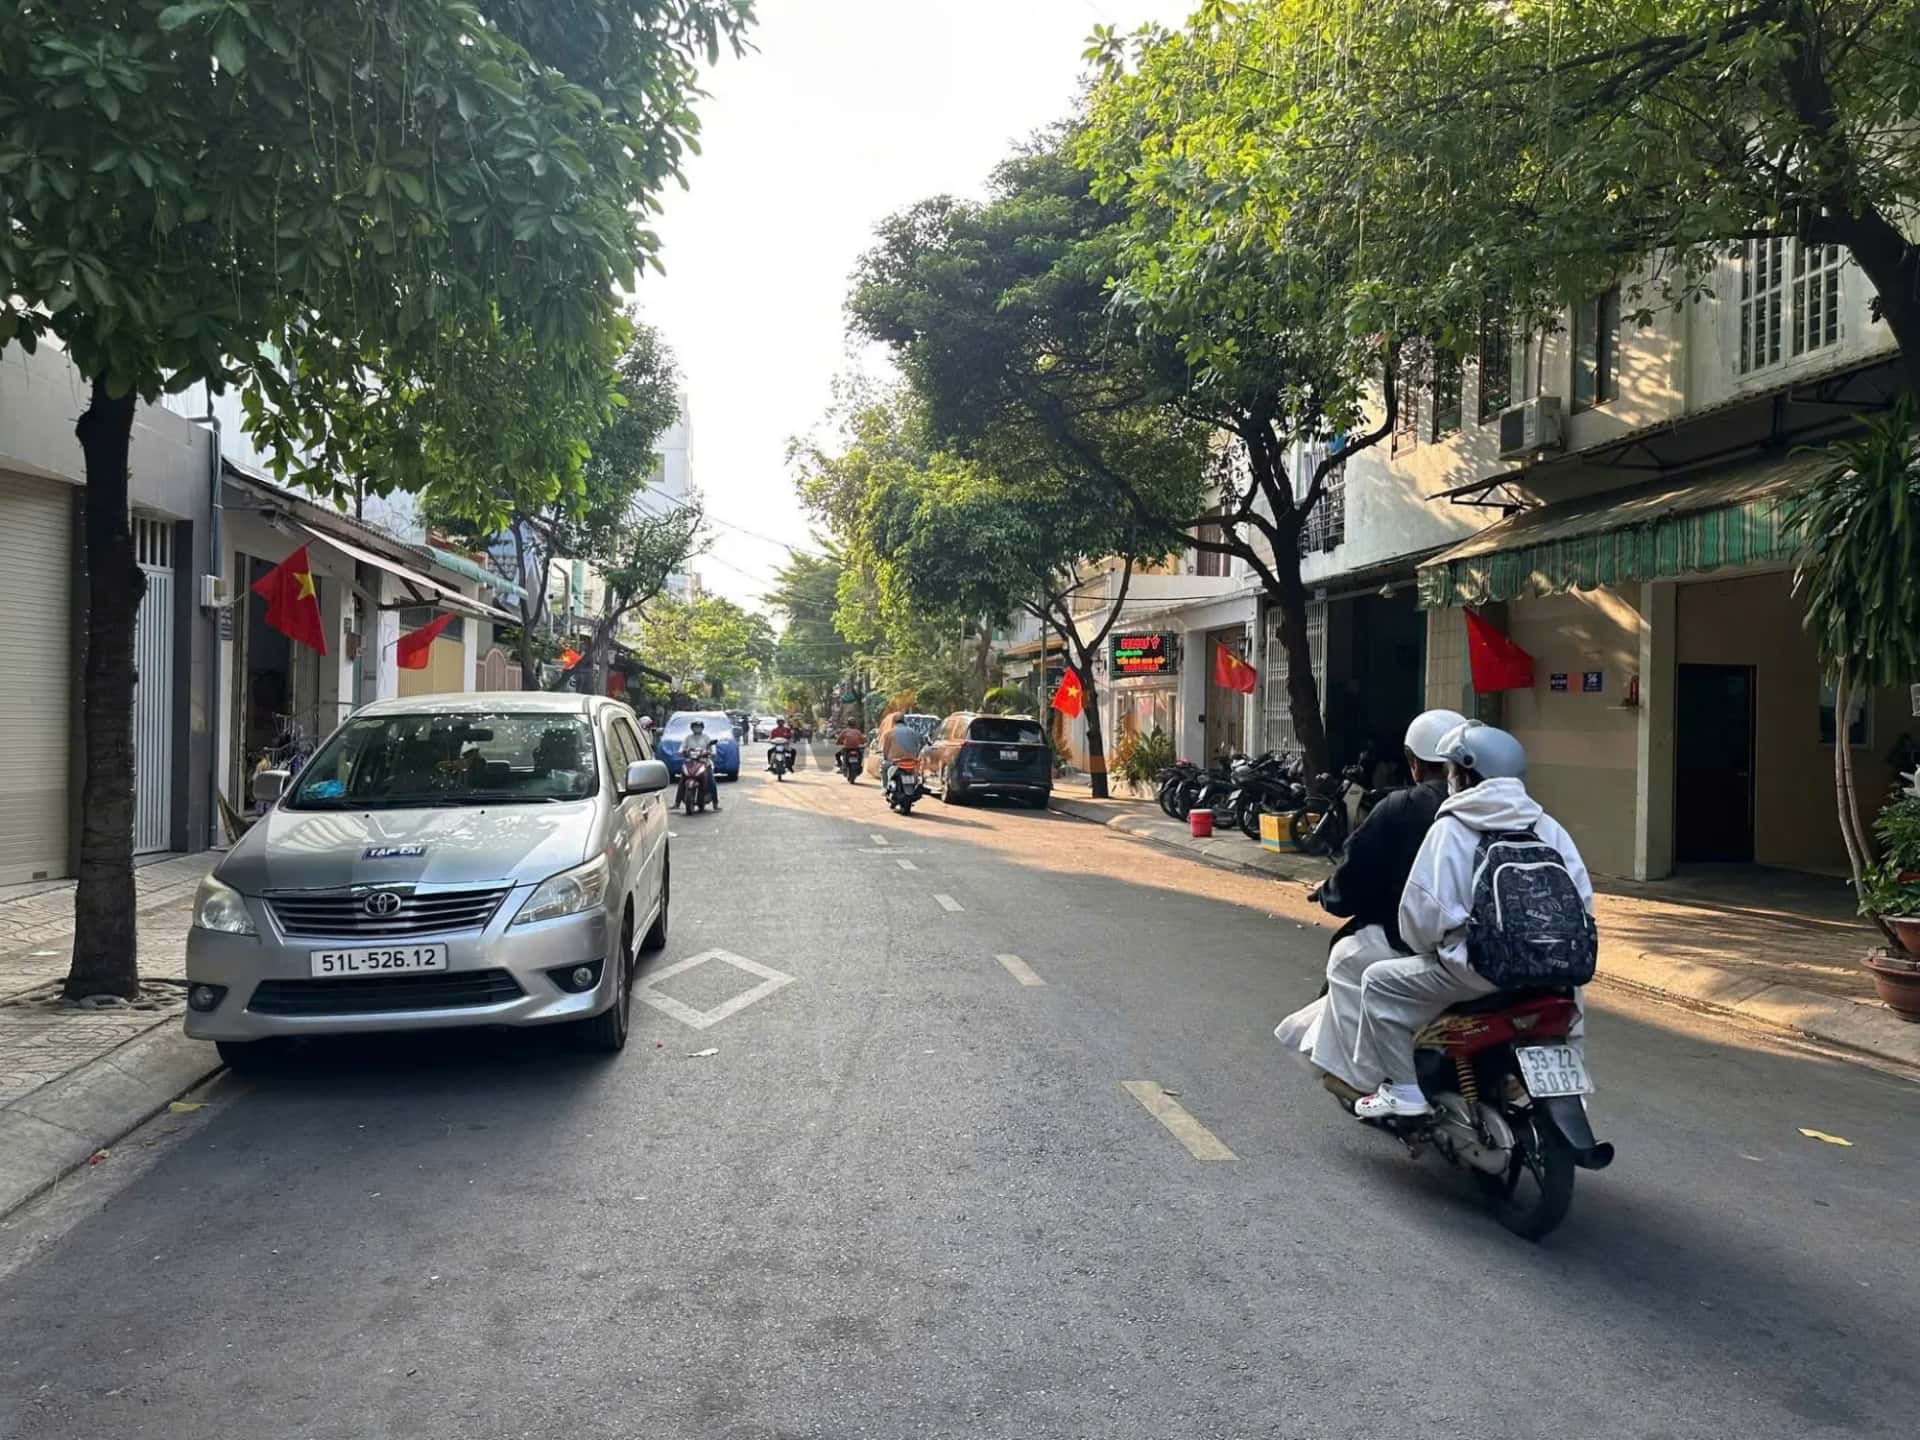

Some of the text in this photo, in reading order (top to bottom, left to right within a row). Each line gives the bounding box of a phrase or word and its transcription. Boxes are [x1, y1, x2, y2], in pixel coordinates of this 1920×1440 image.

[322, 949, 436, 972] 51L-526.12
[1527, 1048, 1577, 1070] 53-Z2
[1534, 1070, 1585, 1093] 5082
